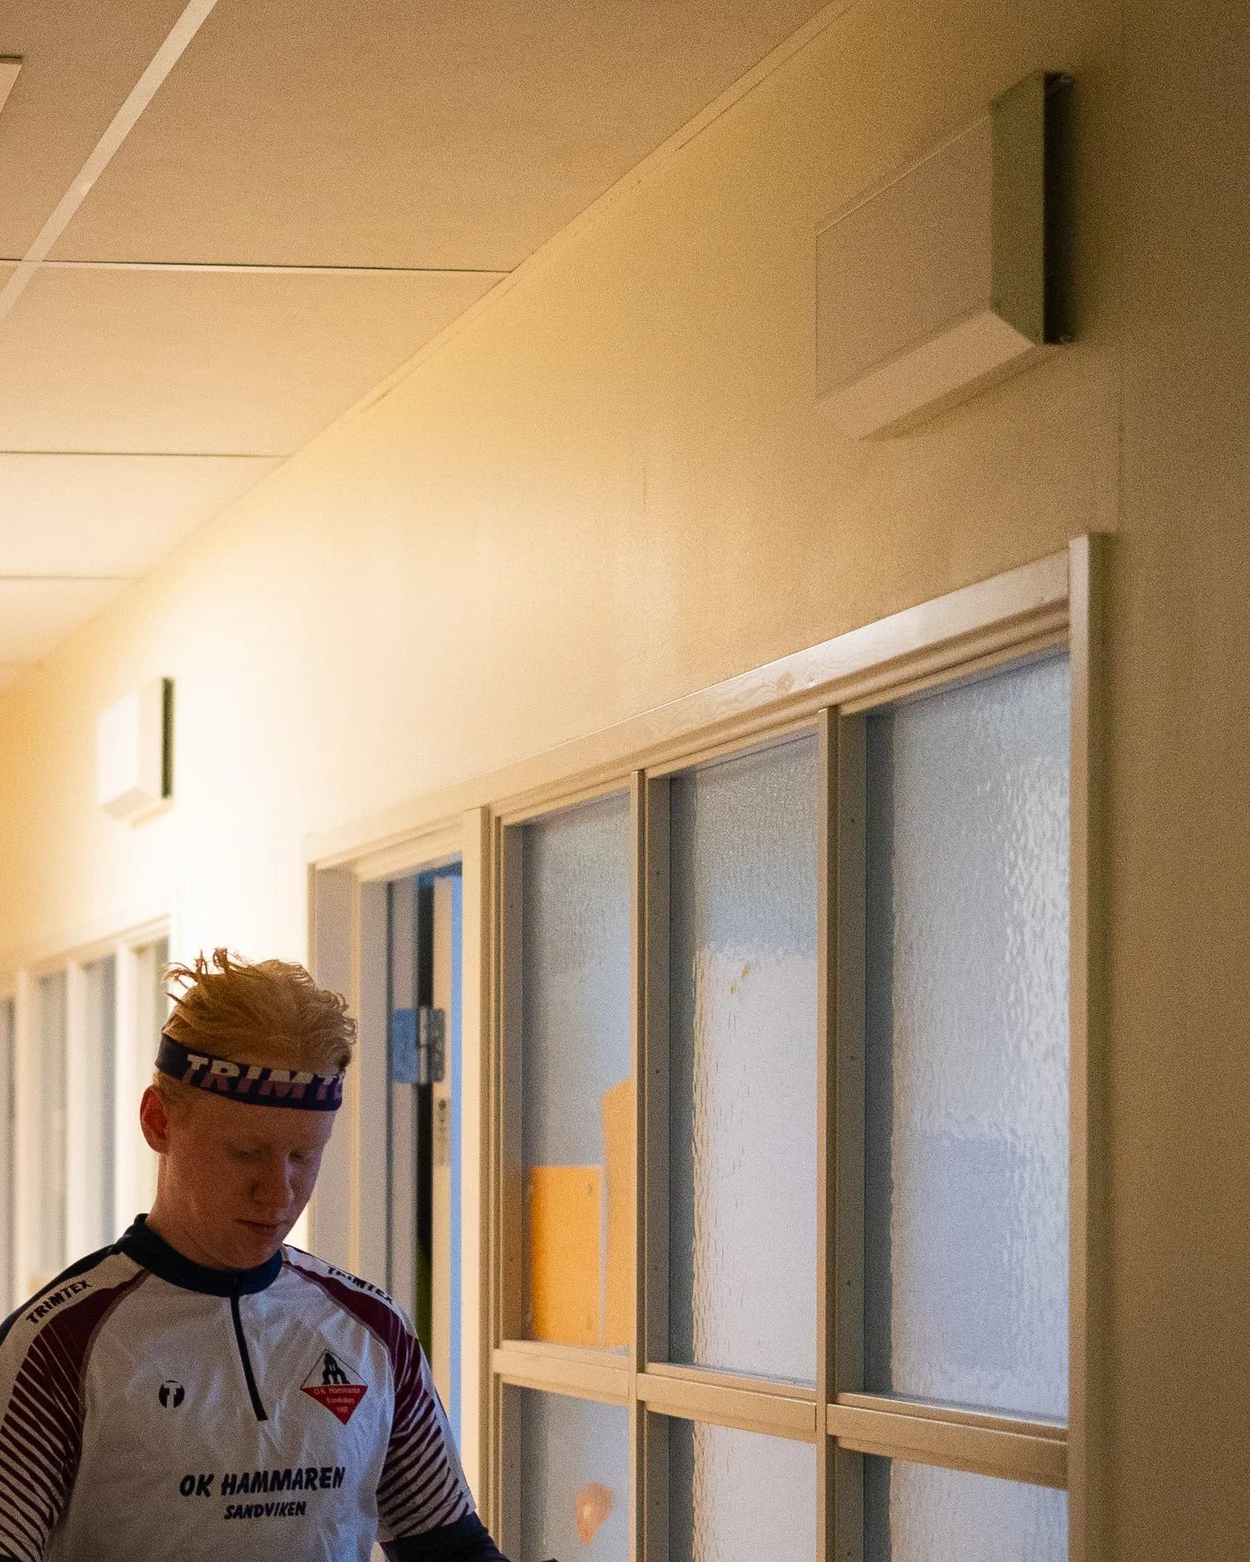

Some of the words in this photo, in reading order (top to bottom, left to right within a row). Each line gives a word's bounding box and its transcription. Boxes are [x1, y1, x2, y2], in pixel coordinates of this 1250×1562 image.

[26, 1280, 92, 1324] TRIMTEX
[179, 1474, 214, 1497] OK
[221, 1466, 346, 1496] HAMMAREN
[223, 1501, 307, 1520] SANDVIKEN
